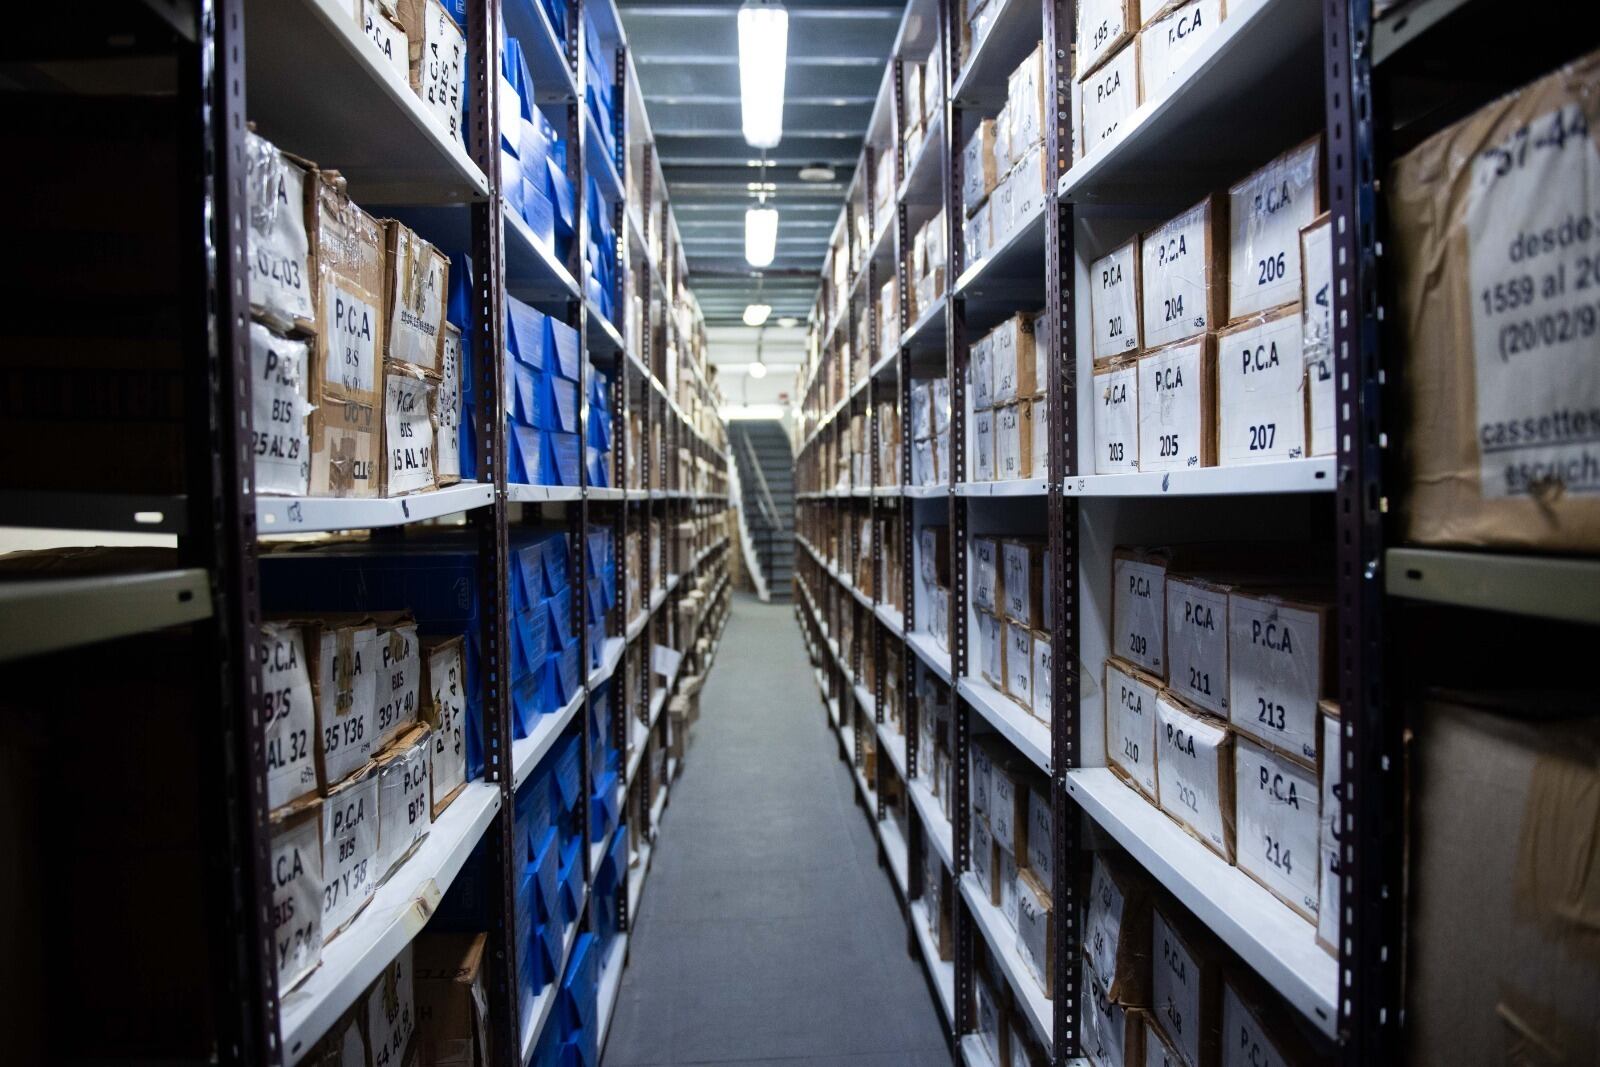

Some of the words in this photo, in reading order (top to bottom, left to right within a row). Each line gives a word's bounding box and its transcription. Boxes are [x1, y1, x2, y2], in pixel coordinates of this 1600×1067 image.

[1094, 20, 1108, 50] 195
[428, 42, 439, 104] P.C.A
[439, 61, 449, 105] BIS
[1097, 70, 1121, 104] P.C.A
[451, 83, 459, 109] AL
[1159, 234, 1187, 267] P.C.A
[1508, 214, 1592, 263] desde
[1103, 263, 1122, 290] P.C.A
[1258, 252, 1286, 286] 206
[1482, 273, 1535, 316] 1559
[1541, 262, 1566, 299] al
[336, 297, 371, 342] P.C.A
[1165, 294, 1184, 322] 204
[1109, 316, 1123, 338] 202
[346, 347, 360, 368] BIS
[1242, 342, 1280, 375] P.C.A
[1156, 365, 1183, 392] P.C.A
[271, 399, 293, 424] BIS
[400, 421, 413, 438] BIS
[1160, 434, 1179, 457] 205
[1250, 424, 1276, 451] 207
[269, 435, 286, 459] AL
[288, 437, 300, 460] 29
[405, 447, 419, 470] AL
[1109, 442, 1124, 461] 203
[1130, 575, 1151, 599] P.C.A
[1185, 600, 1214, 631] P.C.A
[1130, 633, 1147, 655] 209
[1252, 619, 1293, 654] P.C.A
[392, 670, 404, 691] BIS
[1190, 666, 1212, 696] 211
[264, 687, 292, 723] BIS
[379, 704, 393, 731] 39
[395, 697, 402, 716] Y
[404, 690, 414, 714] 40
[1121, 686, 1142, 716] P.C.A
[1258, 697, 1286, 731] 213
[290, 729, 307, 763] 32
[326, 724, 340, 754] 35
[1125, 737, 1140, 764] 210
[1167, 722, 1197, 759] P.C.A
[404, 759, 428, 795] P.C.A
[1259, 764, 1299, 810] P.C.A
[408, 793, 426, 825] BIS
[1176, 780, 1199, 814] 212
[333, 797, 364, 838] P.C.A
[339, 837, 356, 864] BIS
[1265, 835, 1292, 875] 214
[325, 878, 339, 913] 37
[343, 867, 351, 897] Y
[353, 857, 368, 890] 38
[272, 896, 295, 929] BIS
[279, 936, 291, 971] Y
[1165, 939, 1186, 986] P.C.A
